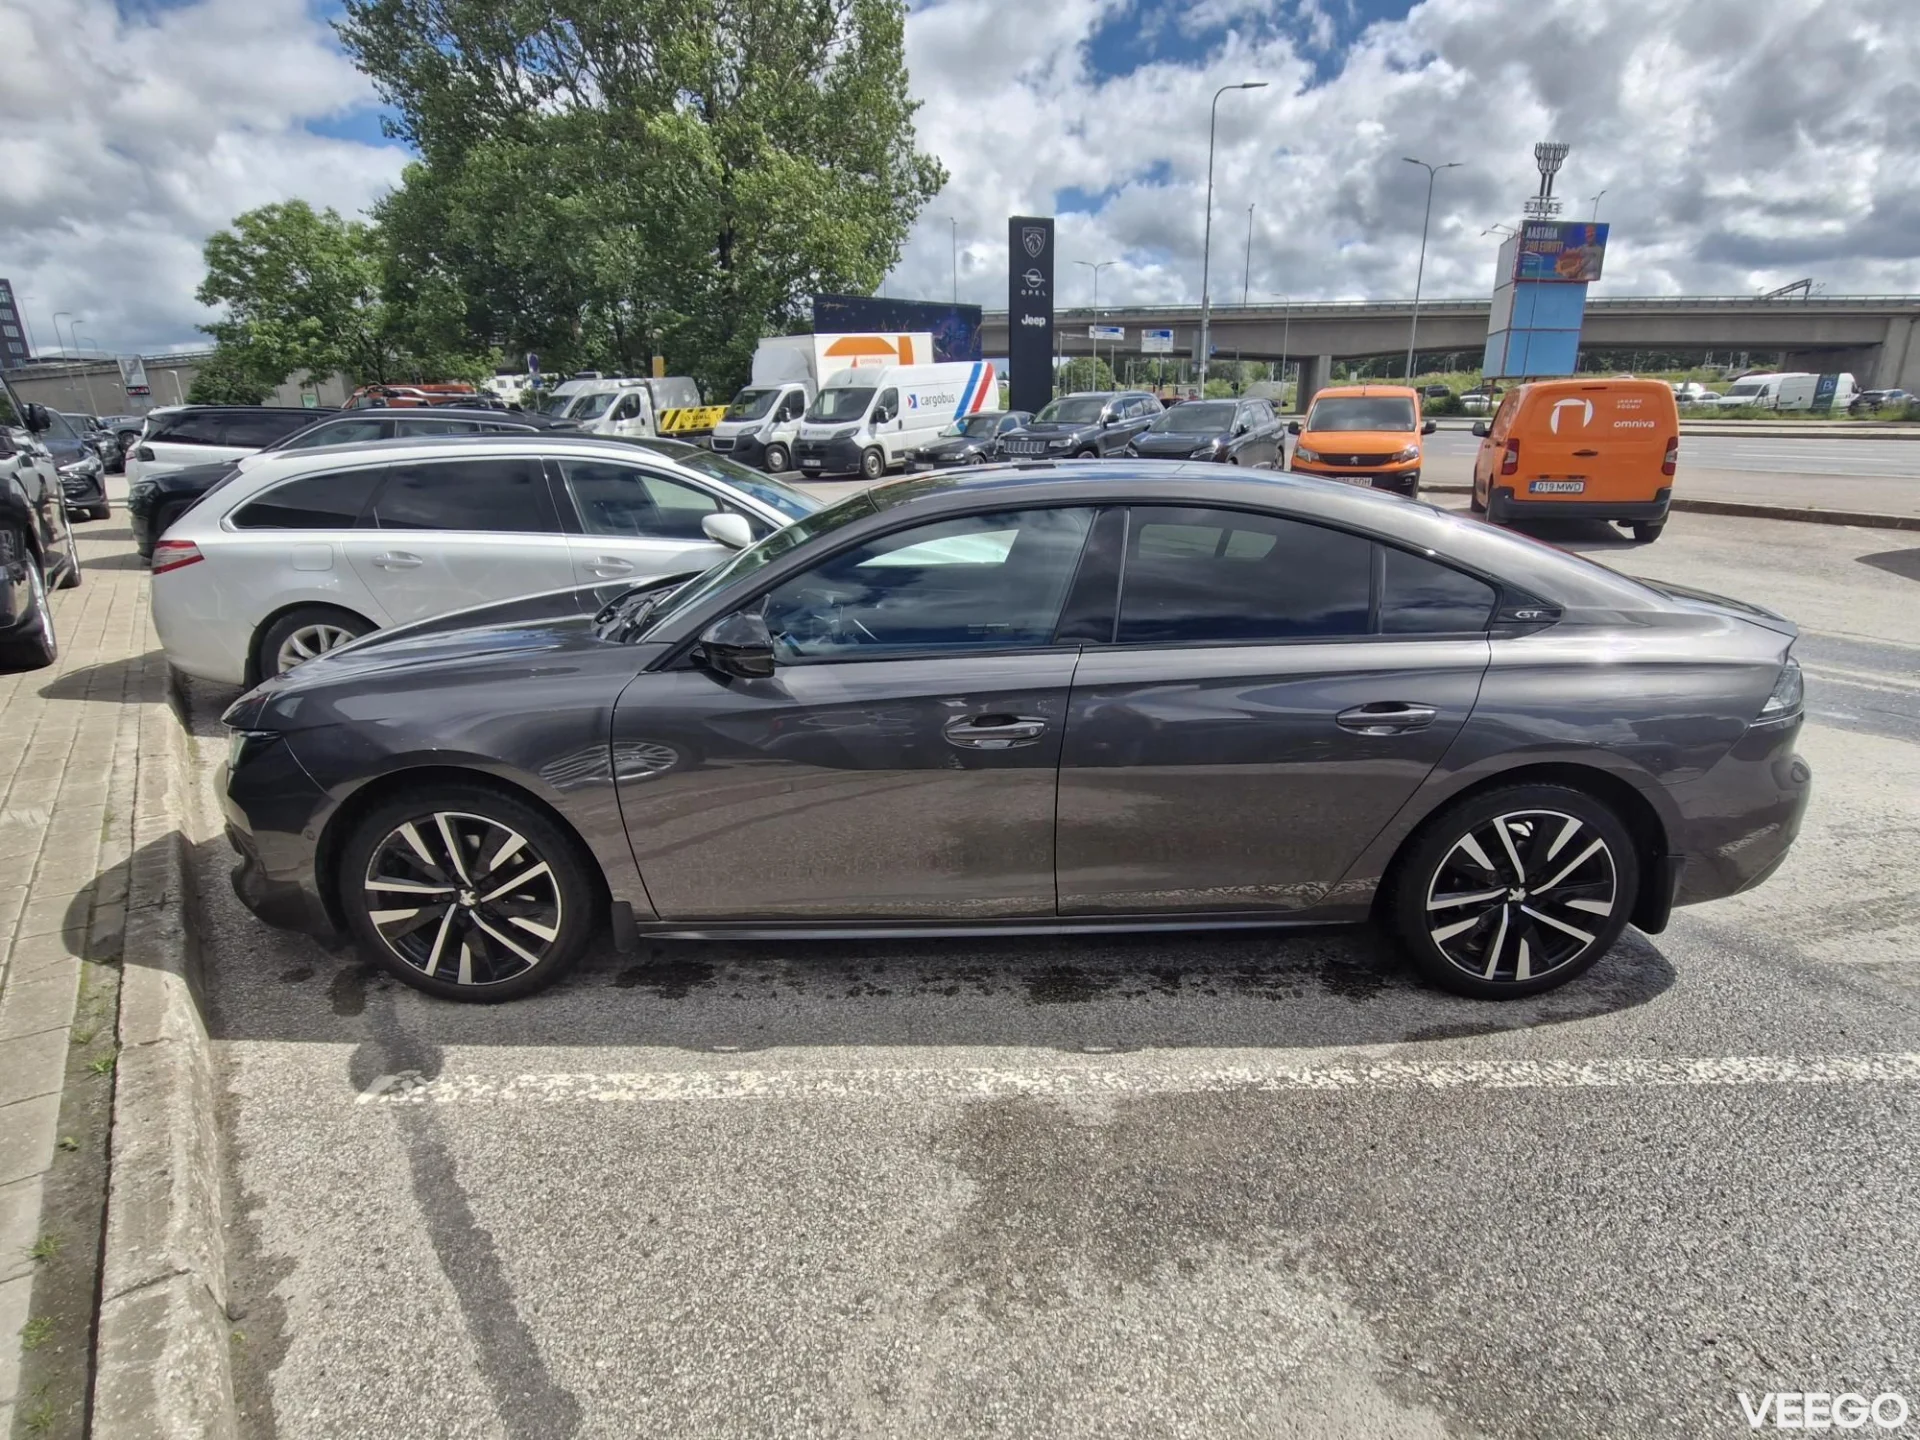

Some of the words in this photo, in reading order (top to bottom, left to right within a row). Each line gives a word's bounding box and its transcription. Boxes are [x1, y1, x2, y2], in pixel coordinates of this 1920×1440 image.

[1526, 226, 1558, 239] AASTAGA
[1021, 314, 1046, 326] Jeep
[920, 392, 955, 408] cargobus
[1613, 419, 1656, 428] omniva
[1537, 482, 1555, 491] 019
[1515, 610, 1543, 619] GT
